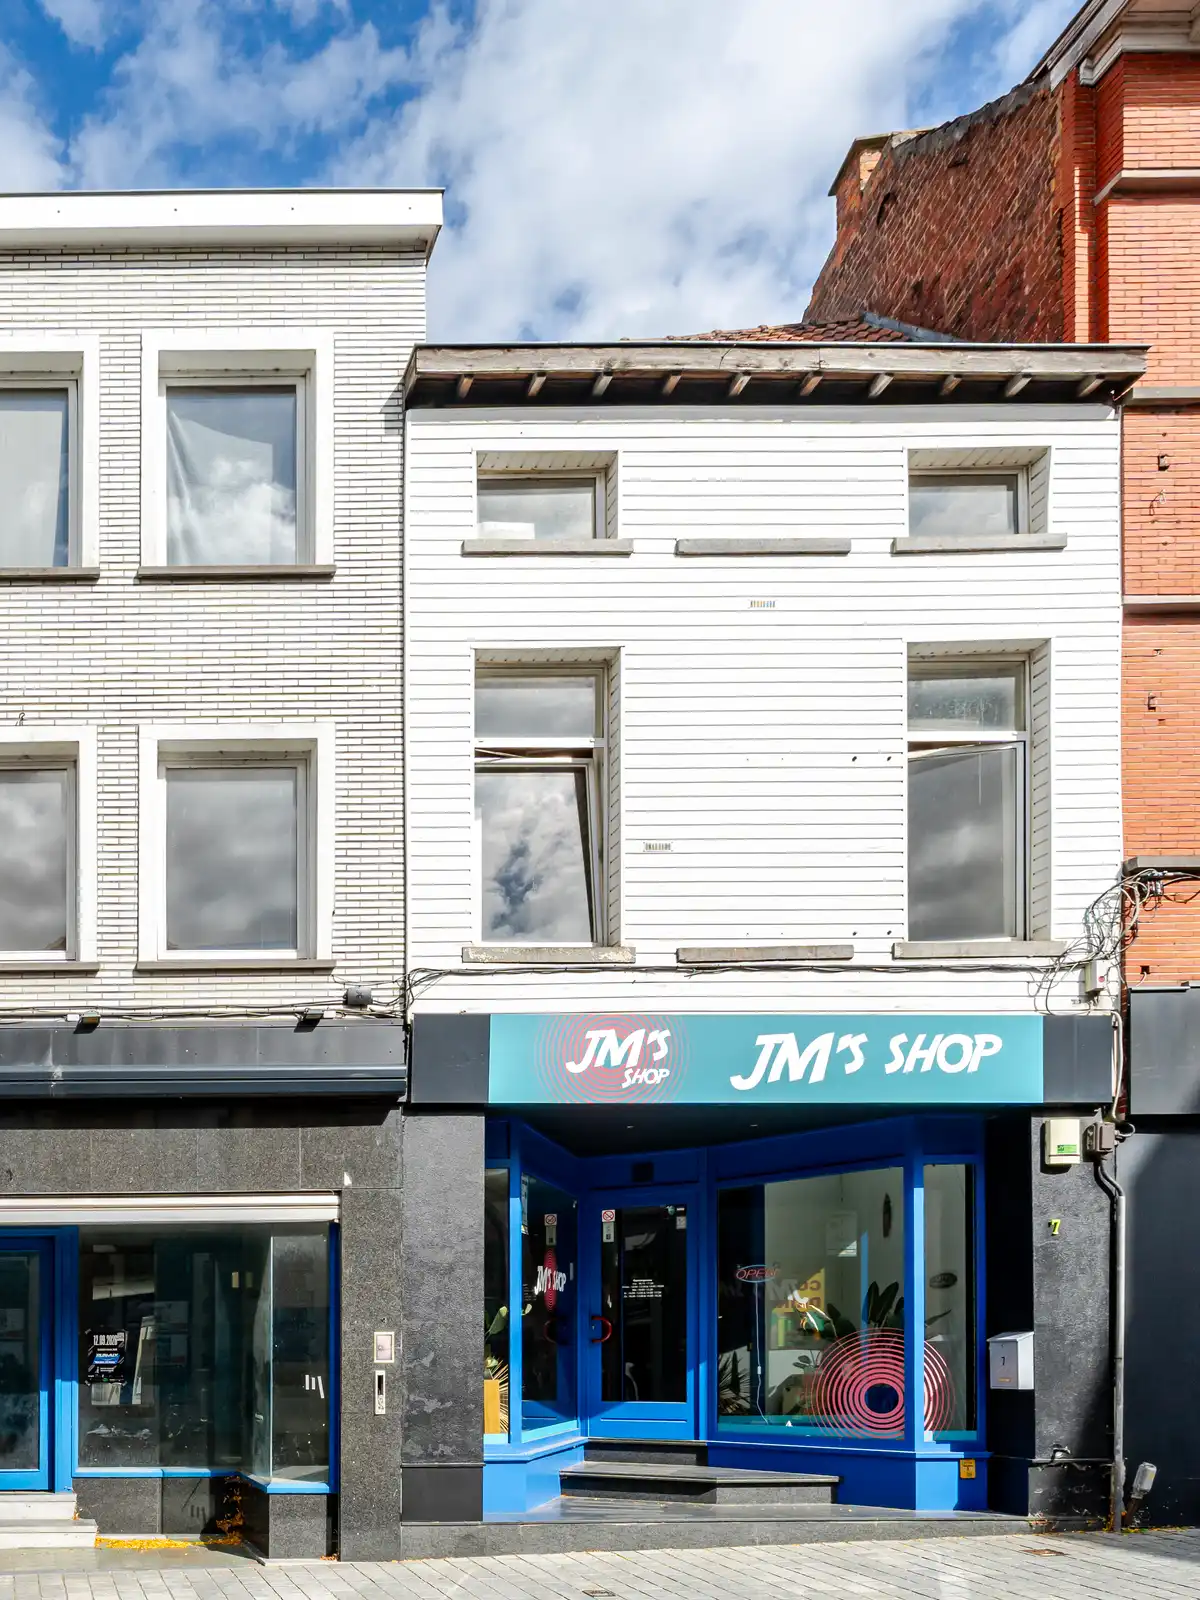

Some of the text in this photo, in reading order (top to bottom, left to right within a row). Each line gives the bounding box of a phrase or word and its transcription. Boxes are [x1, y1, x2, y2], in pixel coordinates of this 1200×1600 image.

[884, 1033, 1003, 1075] SHOP
[621, 1068, 671, 1089] SHOP
[1050, 1218, 1061, 1235] 7
[552, 1270, 567, 1293] SHOP
[736, 1268, 779, 1280] OPEN
[1000, 1356, 1006, 1366] 7
